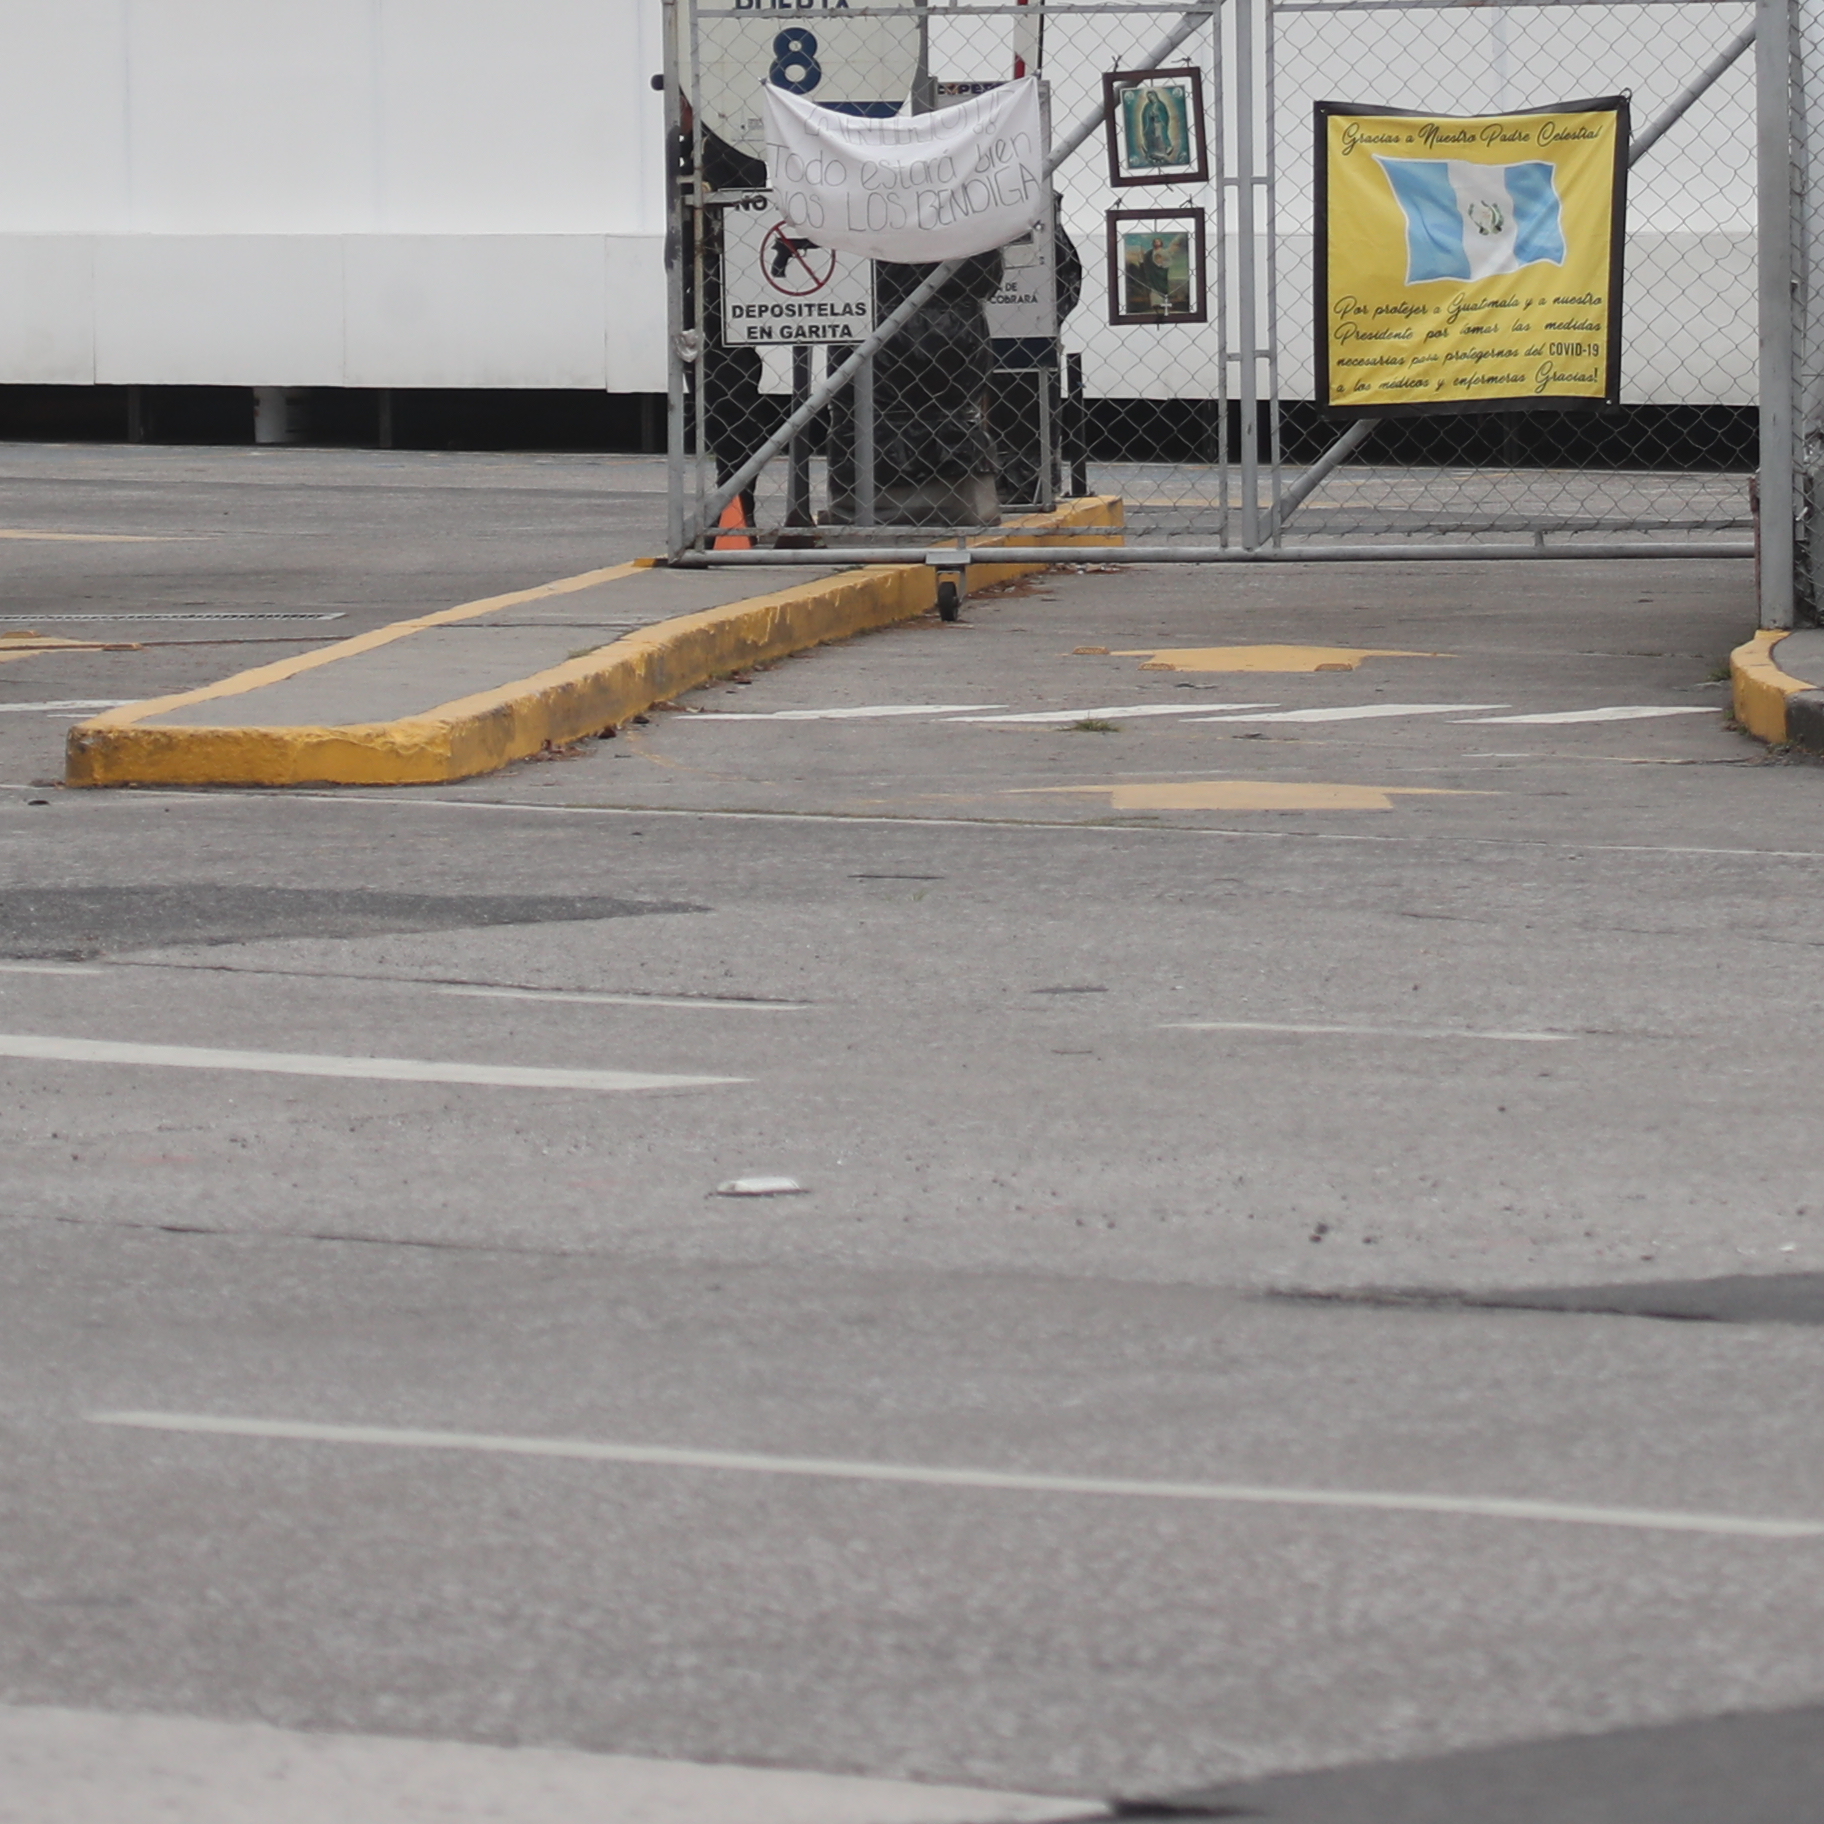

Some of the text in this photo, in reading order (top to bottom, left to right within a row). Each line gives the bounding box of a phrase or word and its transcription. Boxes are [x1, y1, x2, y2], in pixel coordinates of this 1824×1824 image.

[769, 27, 822, 95] 8
[1342, 121, 1604, 156] Gracias a Nuestro Padre Celestial
[766, 131, 1031, 190] Todo estará bien
[847, 190, 907, 232] LOS
[916, 162, 1040, 231] BENDIGA
[731, 302, 867, 319] DEPOSITELAS
[1333, 295, 1369, 320] Por
[1372, 301, 1428, 320] protejer
[1433, 306, 1441, 314] a
[1522, 297, 1534, 311] y
[1538, 297, 1547, 306] a
[1553, 292, 1602, 306] nuestro
[747, 324, 853, 339] EN GARITA
[1333, 321, 1413, 346] Presidente
[1423, 328, 1449, 344] por
[1511, 318, 1532, 332] las
[1544, 317, 1602, 331] medidas
[1337, 356, 1406, 367] necesarias
[1442, 347, 1519, 366] protegernos
[1523, 341, 1547, 357] del
[1549, 342, 1599, 357] COVID-19
[1337, 383, 1345, 393] a
[1354, 379, 1372, 392] los
[1435, 378, 1446, 392] y
[1453, 372, 1527, 390] enfermeras
[1534, 360, 1599, 394] Gracias!
